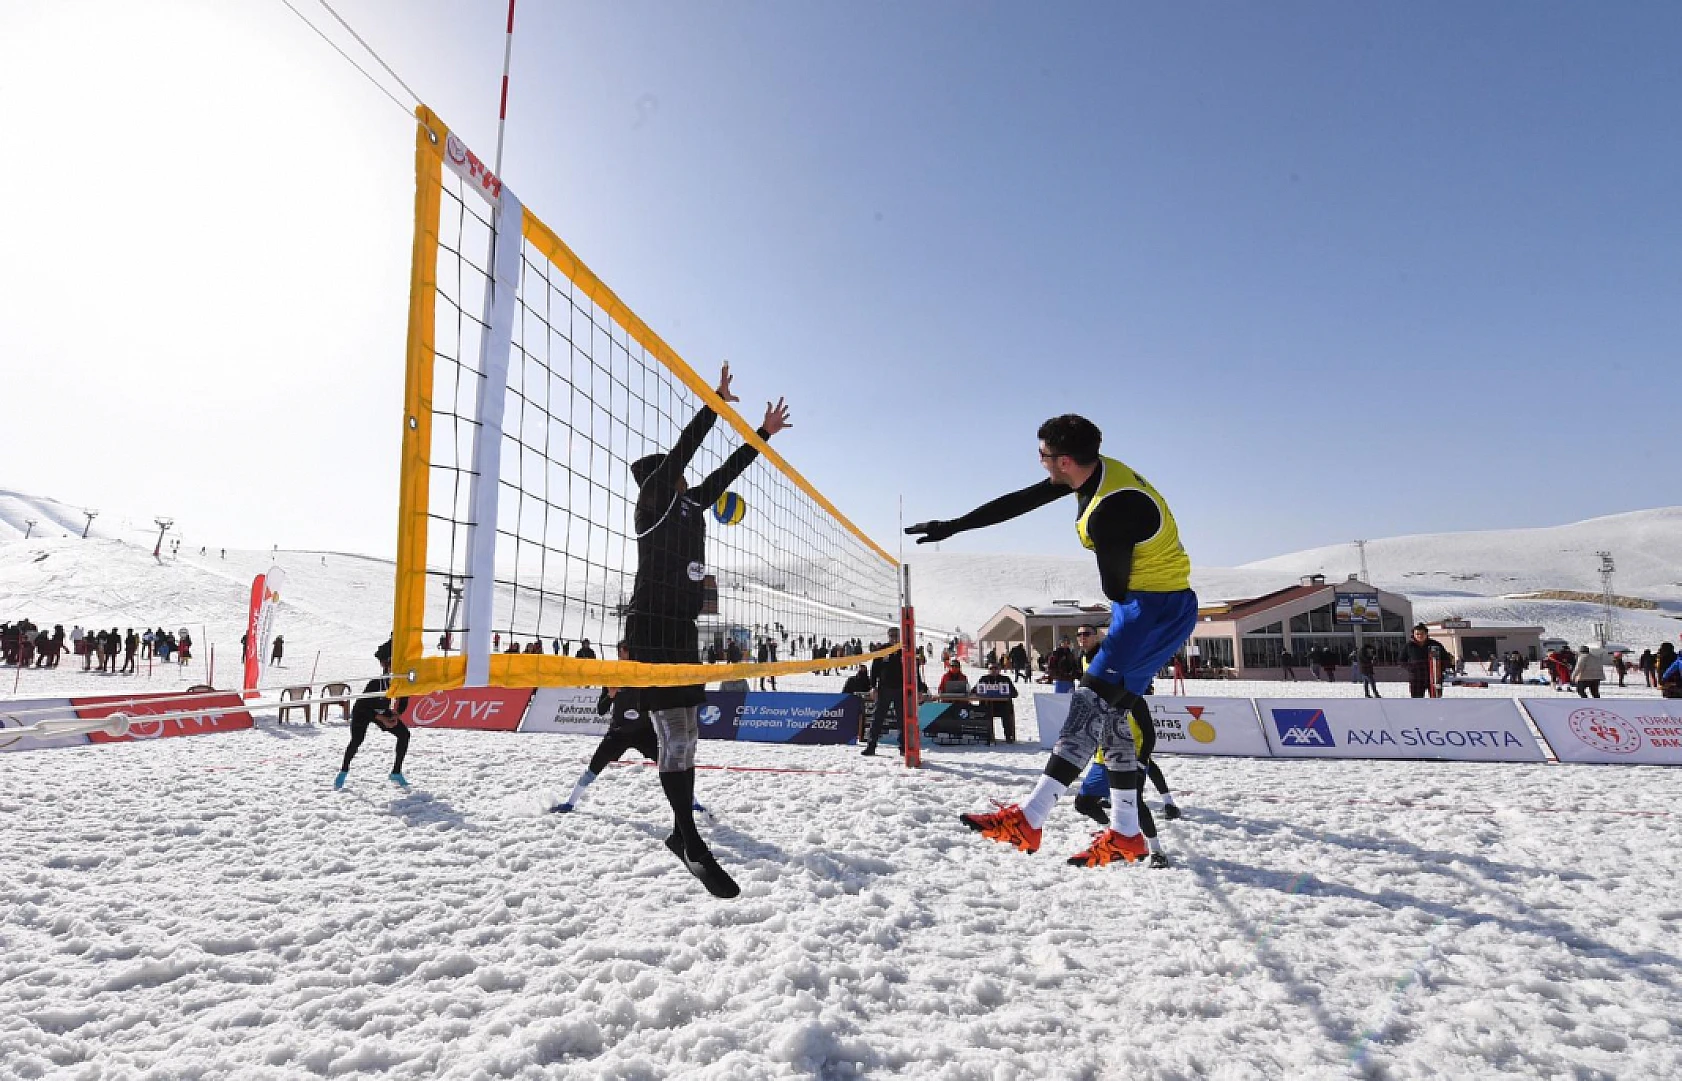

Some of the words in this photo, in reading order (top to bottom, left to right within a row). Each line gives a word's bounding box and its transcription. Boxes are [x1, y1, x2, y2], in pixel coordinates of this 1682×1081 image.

[452, 700, 504, 720] TVF
[558, 704, 598, 715] Kahrama
[736, 705, 757, 715] CEV
[759, 706, 788, 716] Snow
[791, 707, 844, 719] Volleyball
[732, 717, 783, 728] European
[786, 719, 810, 729] Tour
[811, 720, 838, 730] 2022
[1155, 730, 1186, 742] diyesi
[1281, 726, 1325, 744] AXA
[1347, 729, 1397, 745] AXA
[1400, 727, 1523, 748] SİGORTA
[1650, 739, 1682, 747] BAK
